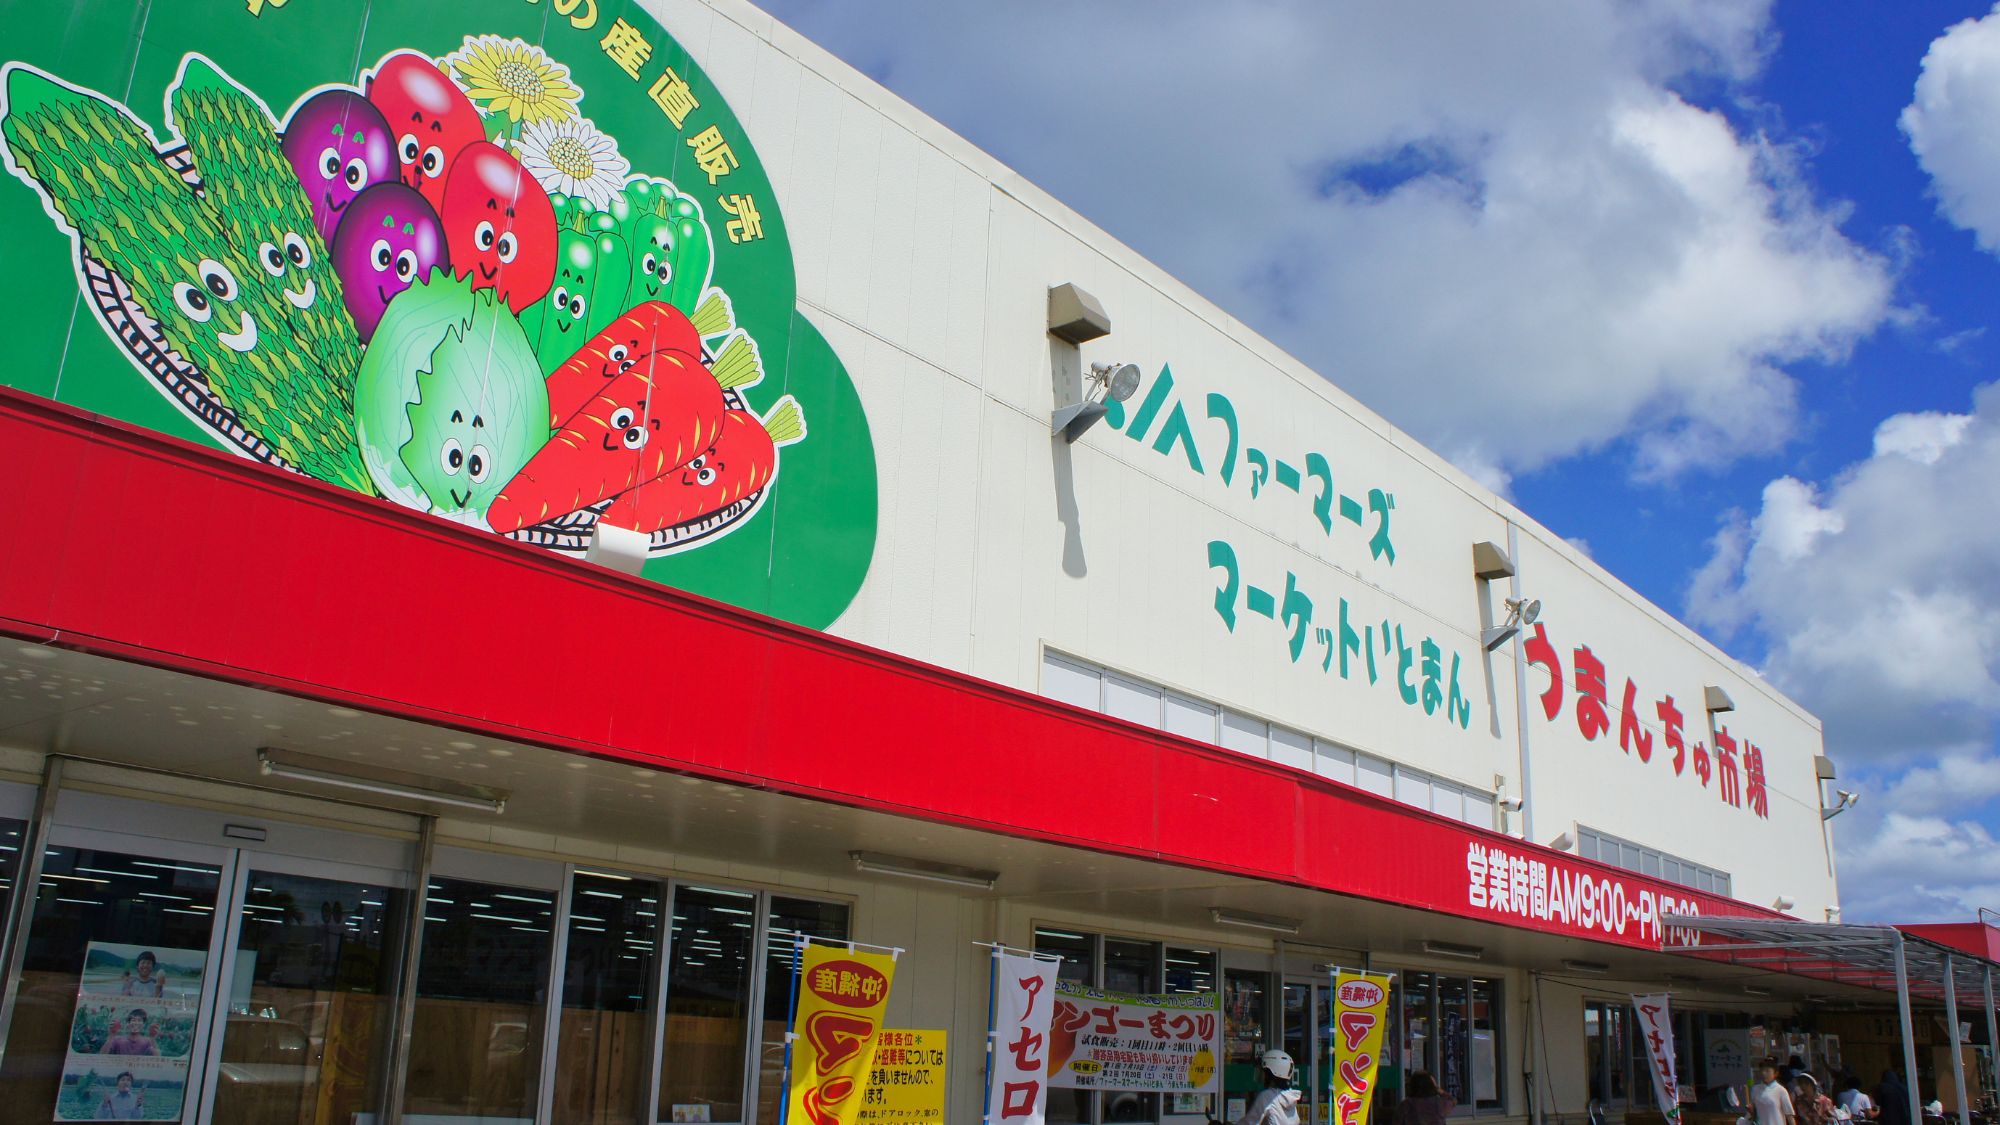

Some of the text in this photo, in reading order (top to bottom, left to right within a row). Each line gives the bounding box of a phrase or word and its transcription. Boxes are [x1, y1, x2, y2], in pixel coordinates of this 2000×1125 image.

[1206, 392, 1396, 568] ファーマーズ
[1206, 540, 1471, 731] マーケットいとまん
[1523, 621, 1769, 820] うまんちゅ市場
[1001, 975, 1044, 1121] アセロ
